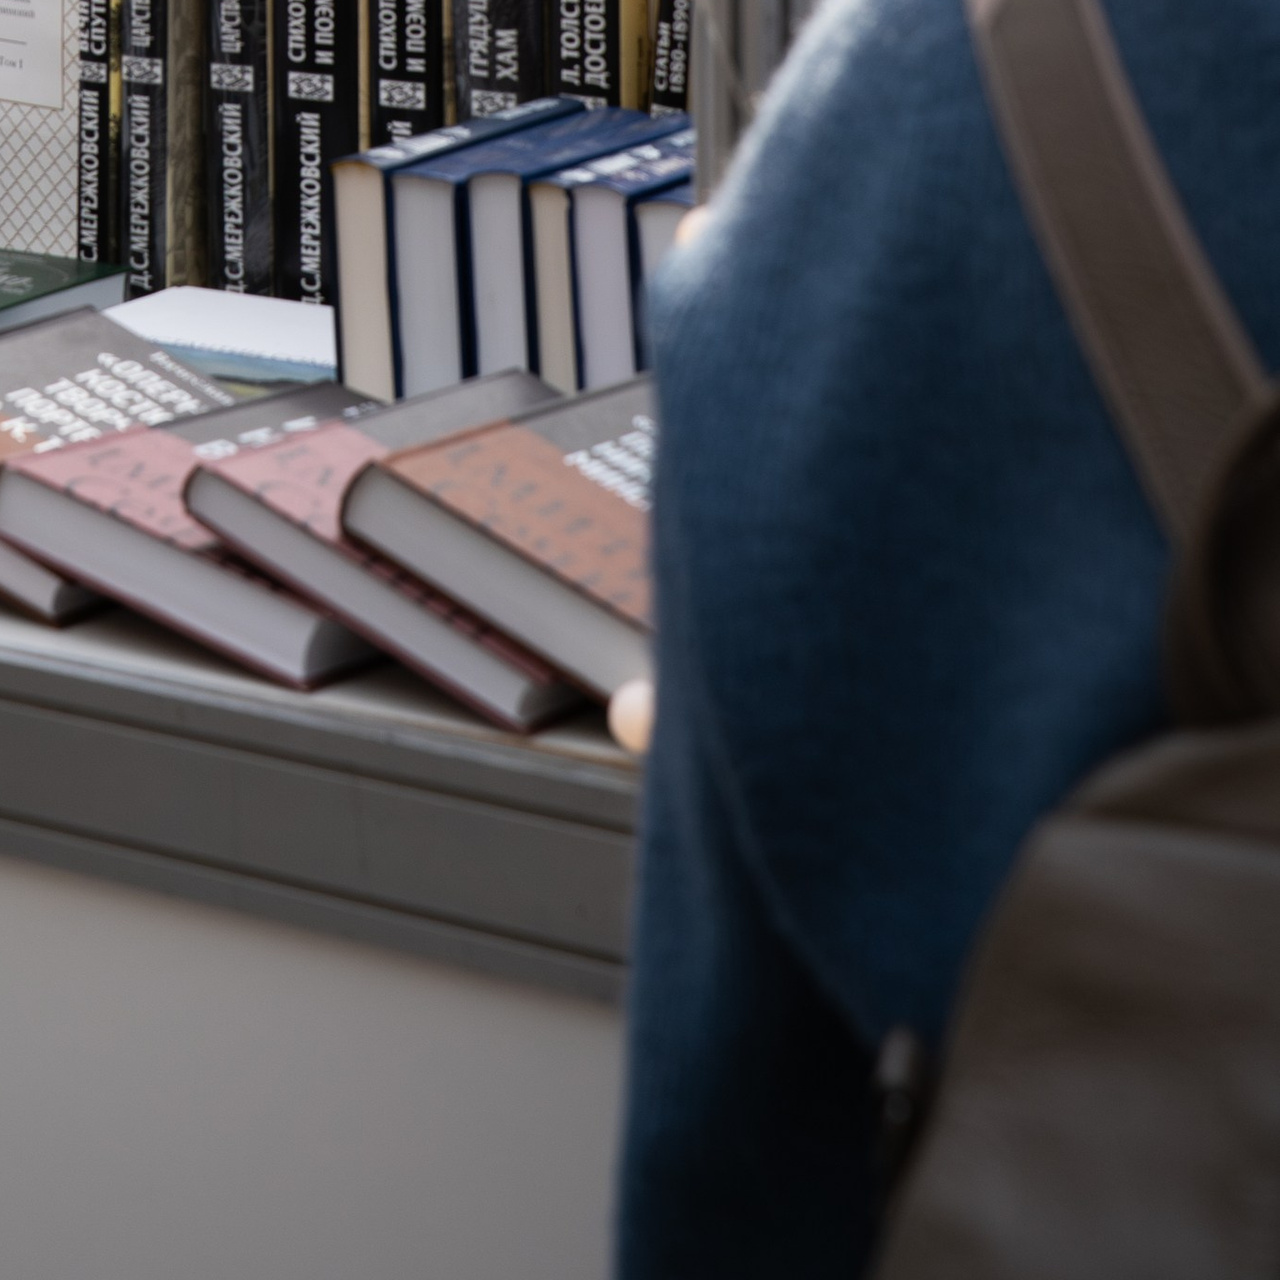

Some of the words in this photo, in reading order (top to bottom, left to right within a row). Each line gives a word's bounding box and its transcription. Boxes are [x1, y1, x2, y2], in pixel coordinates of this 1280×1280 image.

[315, 50, 335, 65] И
[406, 57, 426, 72] И
[495, 28, 519, 81] ХАМ
[654, 21, 671, 92] СТАТЬИ
[561, 65, 581, 86] Л.
